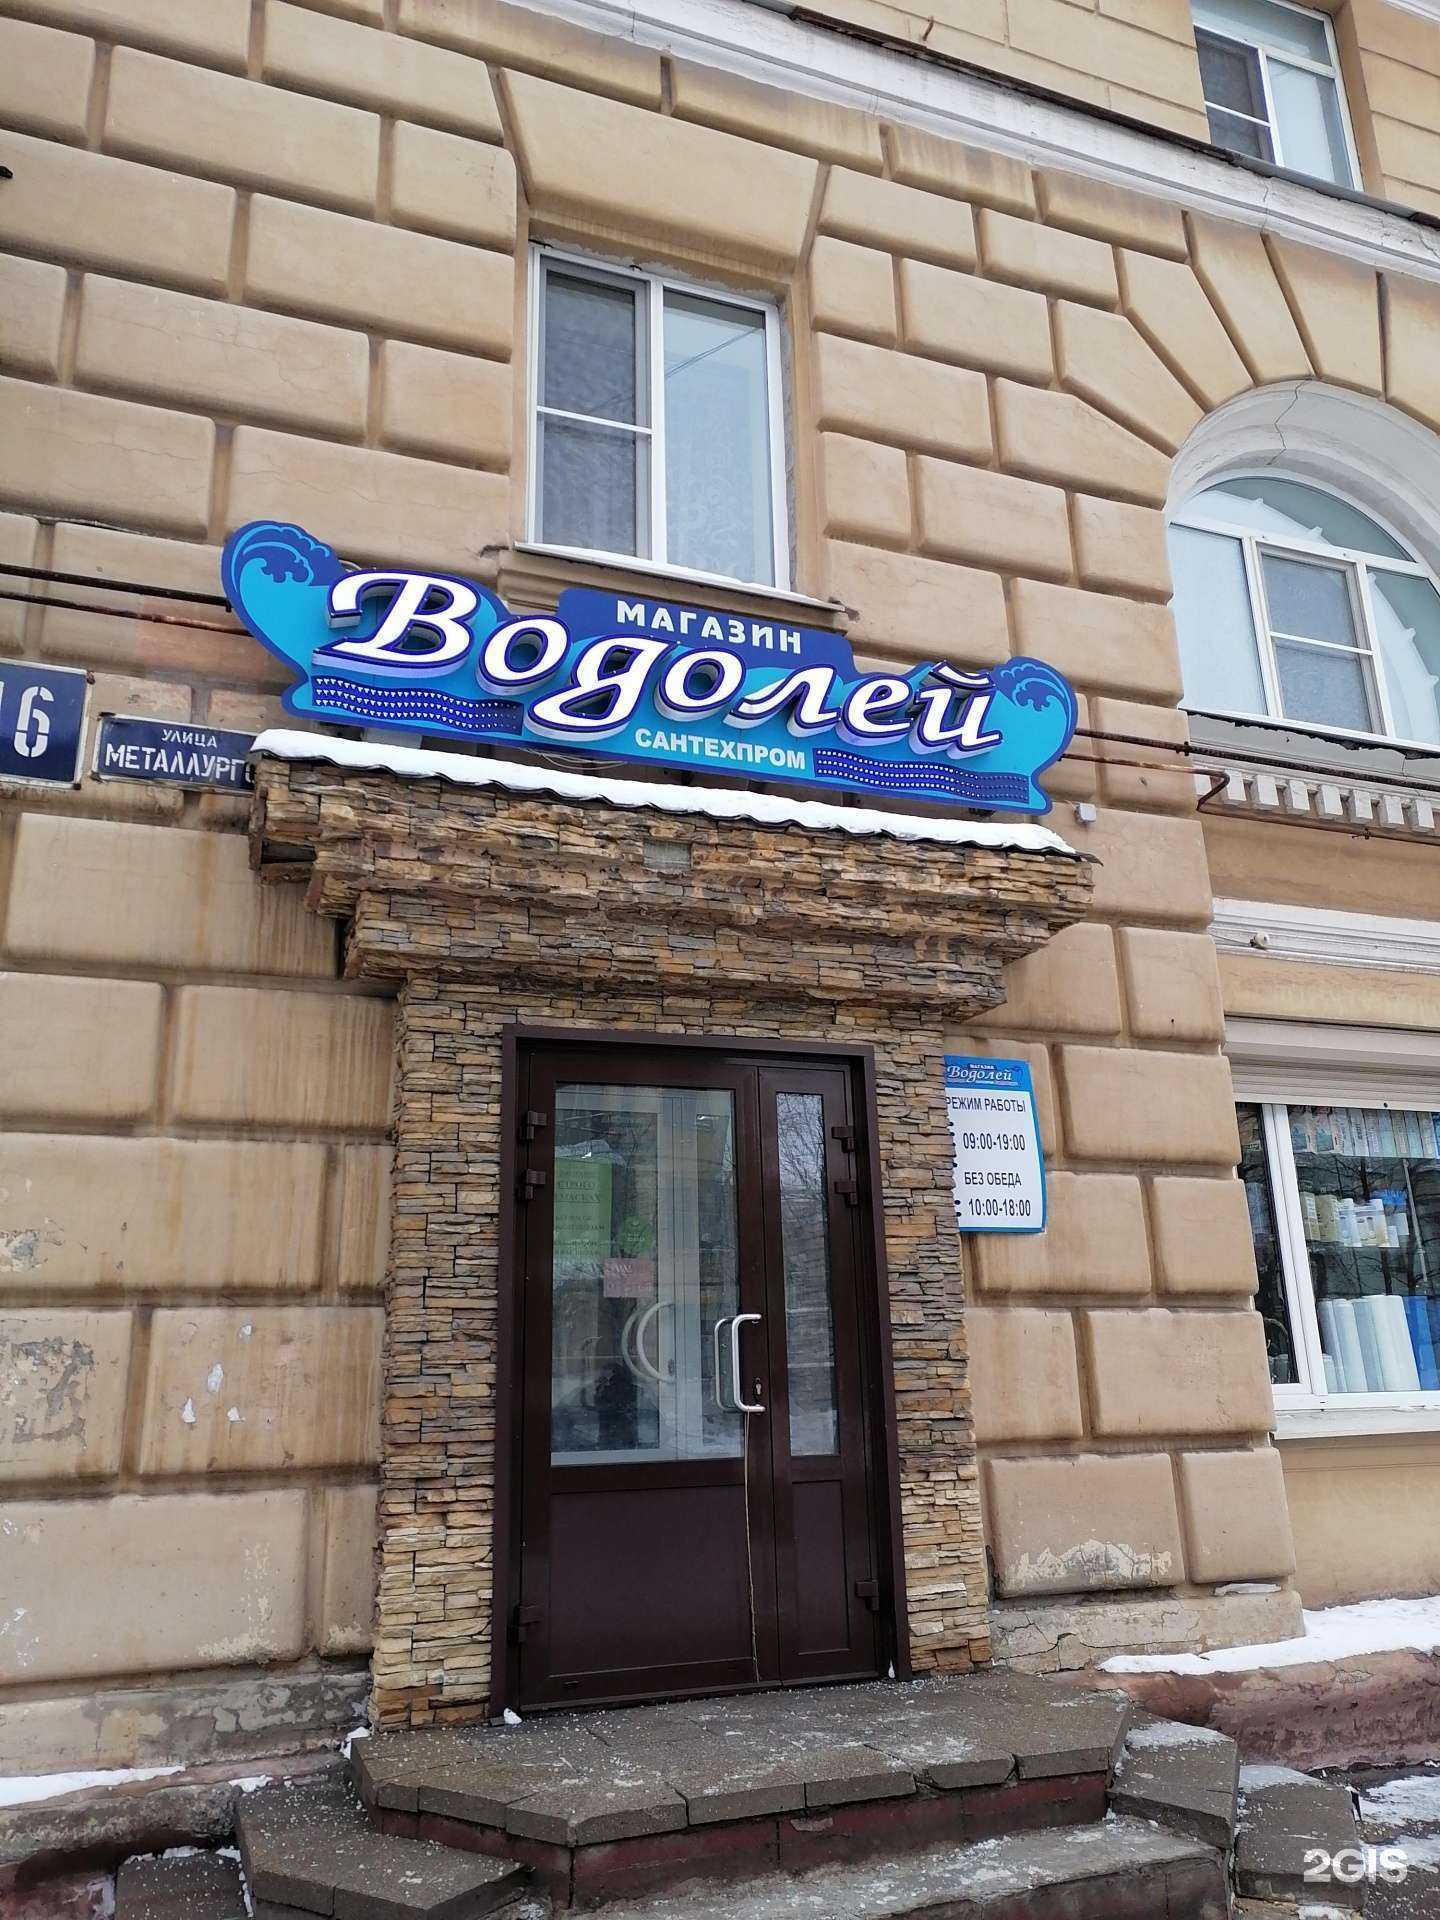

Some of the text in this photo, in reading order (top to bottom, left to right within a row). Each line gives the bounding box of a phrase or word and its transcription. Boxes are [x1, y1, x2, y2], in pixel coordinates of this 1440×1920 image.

[616, 600, 802, 654] МАГАЗИН
[312, 568, 1003, 753] Водолей
[0, 681, 54, 758] 6
[161, 728, 218, 749] УЛИЦА
[634, 727, 806, 770] САНТЕХПРОМ
[947, 1065, 1013, 1082] Водолей
[984, 1099, 1026, 1112] РАБОТЫ
[963, 1132, 1026, 1151] 09:00-19:00
[964, 1172, 1022, 1188] БЕЗ ОБЕДА
[968, 1198, 1031, 1217] 10:00-18:00
